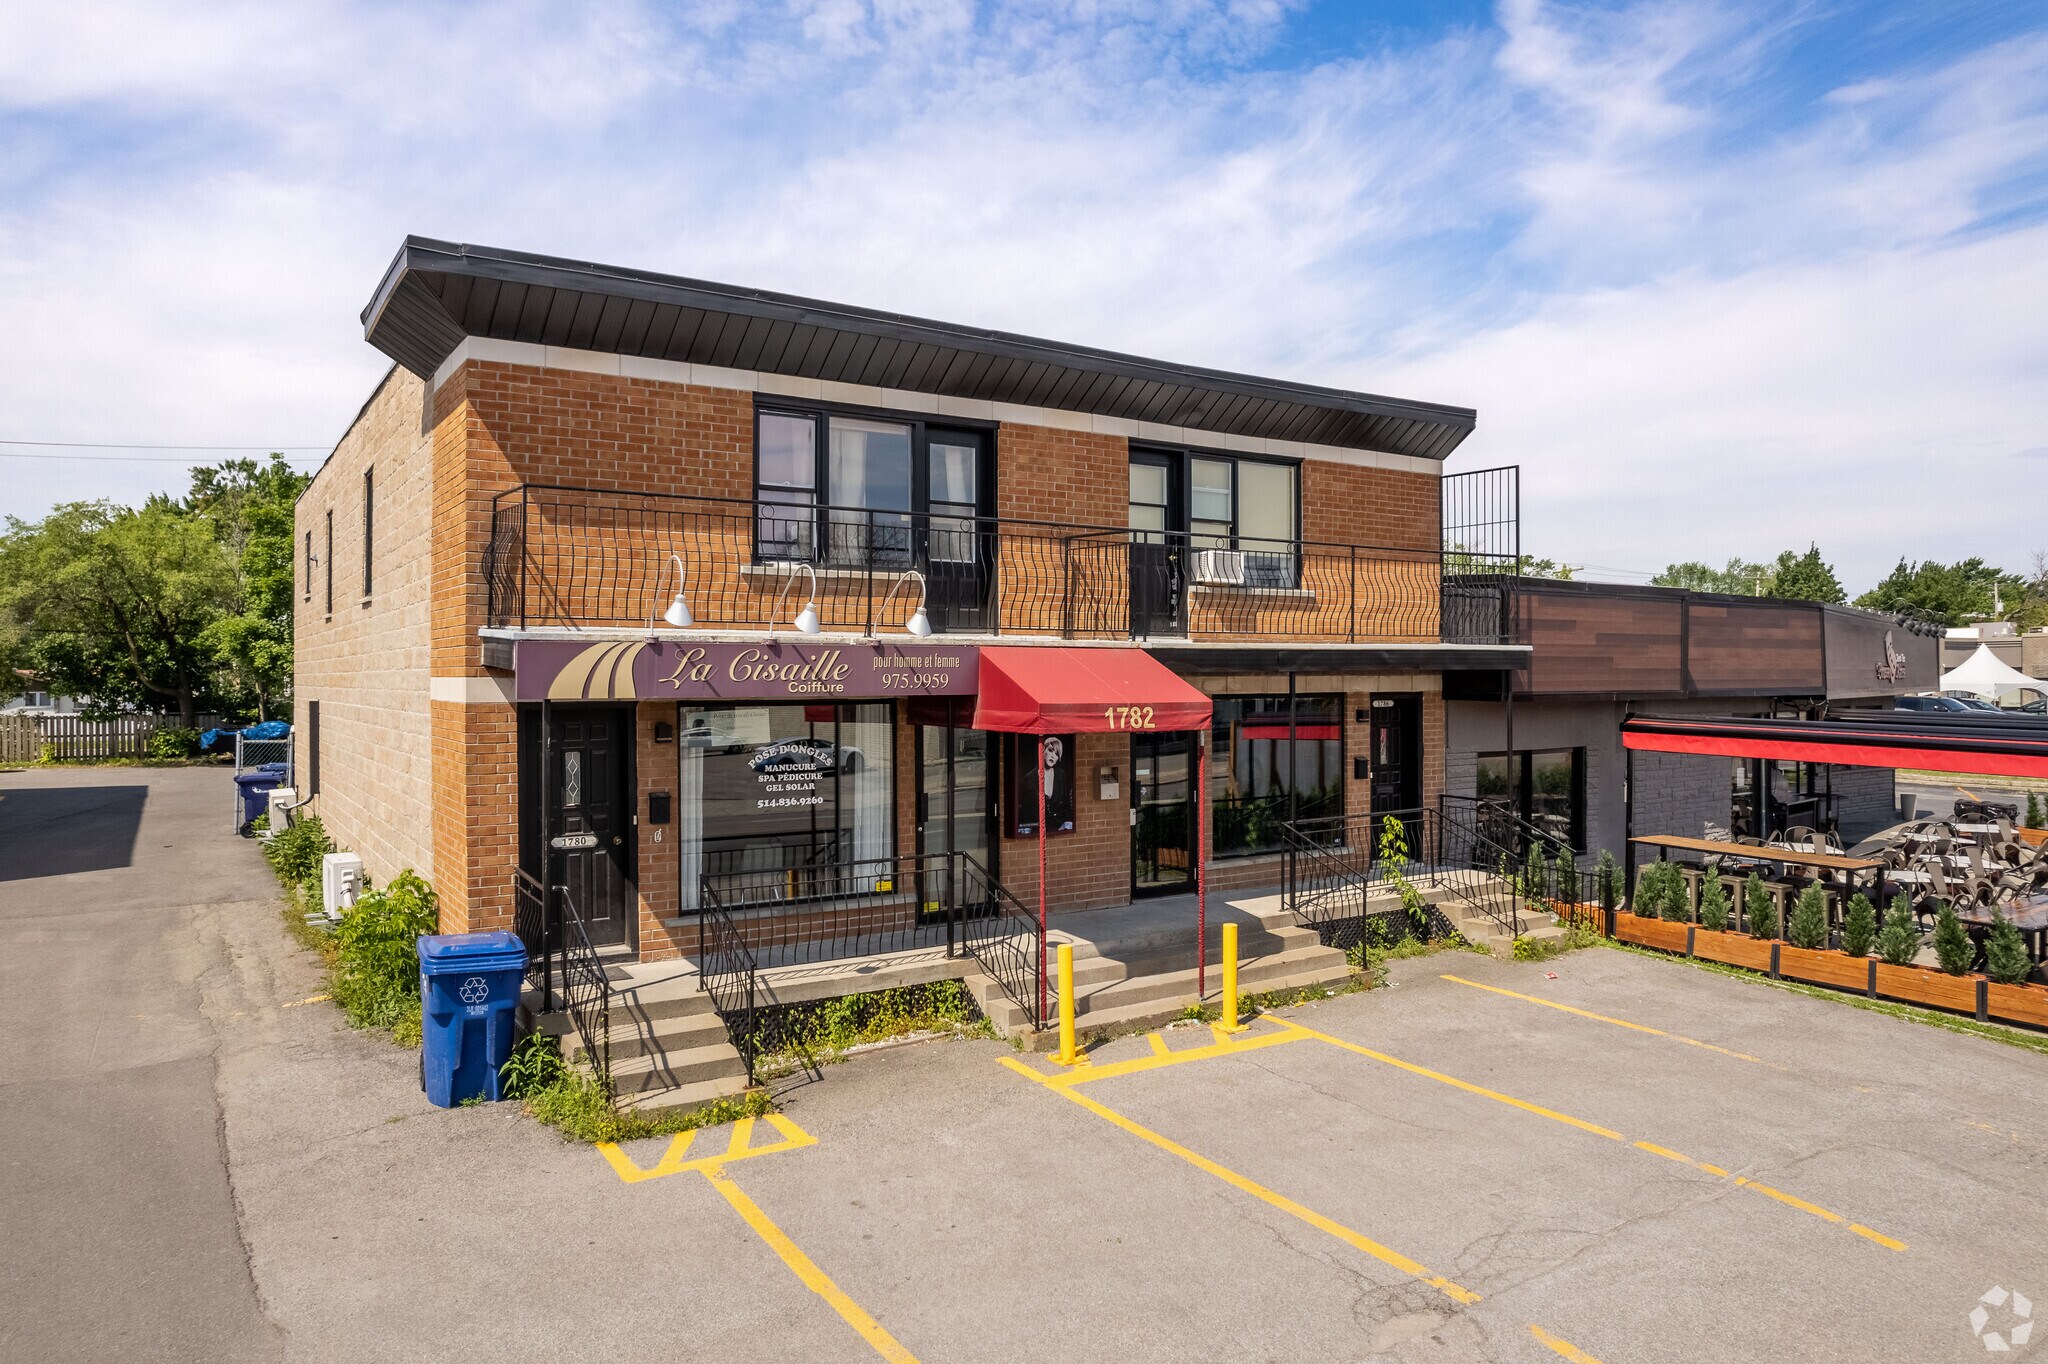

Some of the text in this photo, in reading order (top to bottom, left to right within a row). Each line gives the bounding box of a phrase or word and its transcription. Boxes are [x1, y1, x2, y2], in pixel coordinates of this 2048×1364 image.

[658, 647, 853, 689] La Cisaille
[873, 653, 960, 671] pour homme et femme
[882, 673, 949, 689] 975.9959
[788, 682, 844, 694] Coiffure
[1104, 706, 1156, 730] 1782
[747, 744, 833, 769] POSE D'ONGLES
[764, 763, 817, 772] MANUCURE
[757, 772, 823, 783] SPA PÉDICURE
[766, 783, 816, 792] GEL SOLAR
[757, 797, 824, 809] 514.836.9260
[562, 837, 587, 847] 1780
